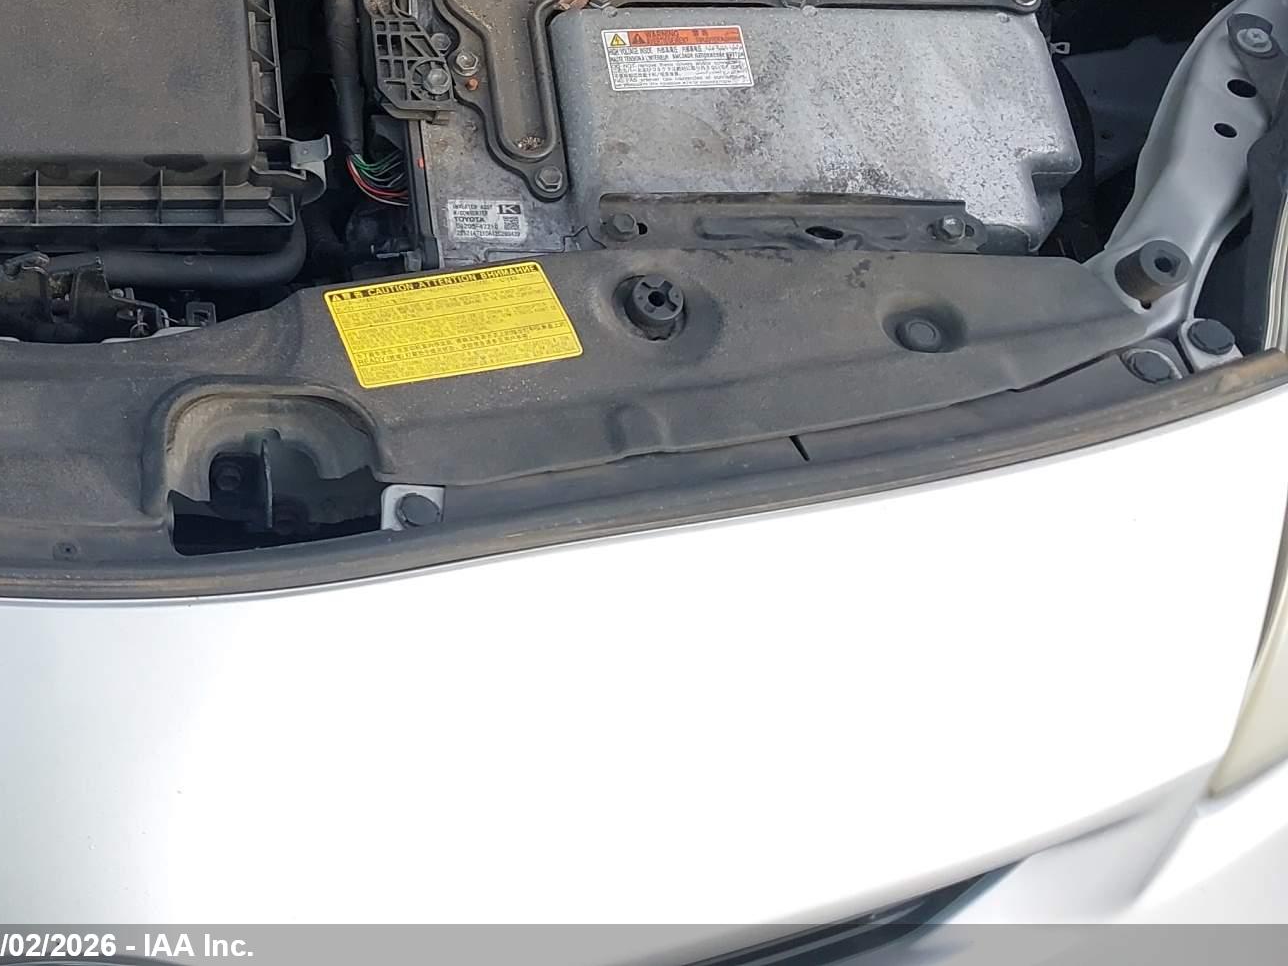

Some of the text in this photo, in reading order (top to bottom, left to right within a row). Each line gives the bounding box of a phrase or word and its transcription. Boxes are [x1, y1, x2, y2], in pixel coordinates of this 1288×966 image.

[367, 283, 414, 297] CAUTION
[418, 274, 477, 289] ATTENTION
[480, 265, 537, 279] ВНИМАНИЕ
